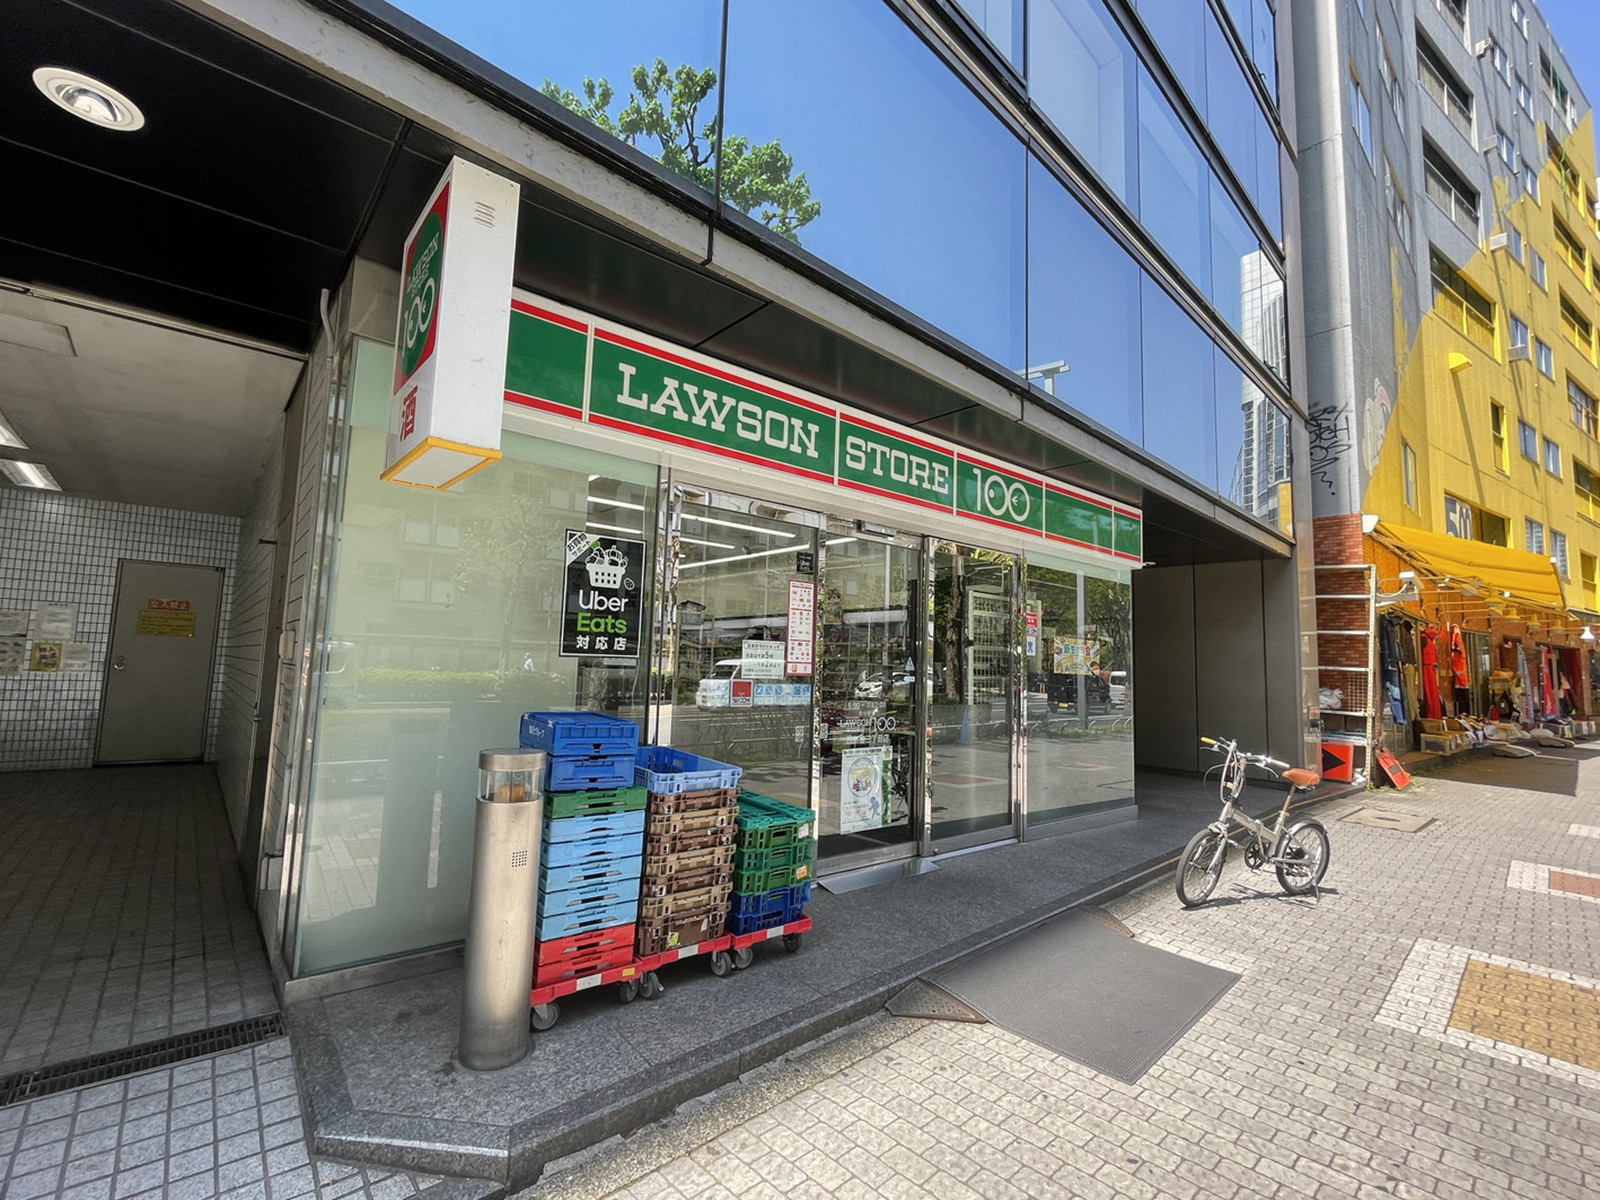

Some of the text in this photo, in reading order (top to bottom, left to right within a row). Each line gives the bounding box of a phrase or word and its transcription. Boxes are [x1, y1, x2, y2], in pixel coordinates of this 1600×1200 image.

[403, 277, 434, 357] 100
[400, 386, 418, 441] 酒
[616, 362, 1031, 523] LAWSON STORE 100
[567, 532, 588, 552] お買物
[572, 540, 591, 557] サポート
[150, 599, 188, 609] 立入禁止
[578, 589, 629, 612] Uber
[576, 612, 627, 634] Eats
[576, 634, 627, 651] 対応店
[873, 716, 896, 731] 100
